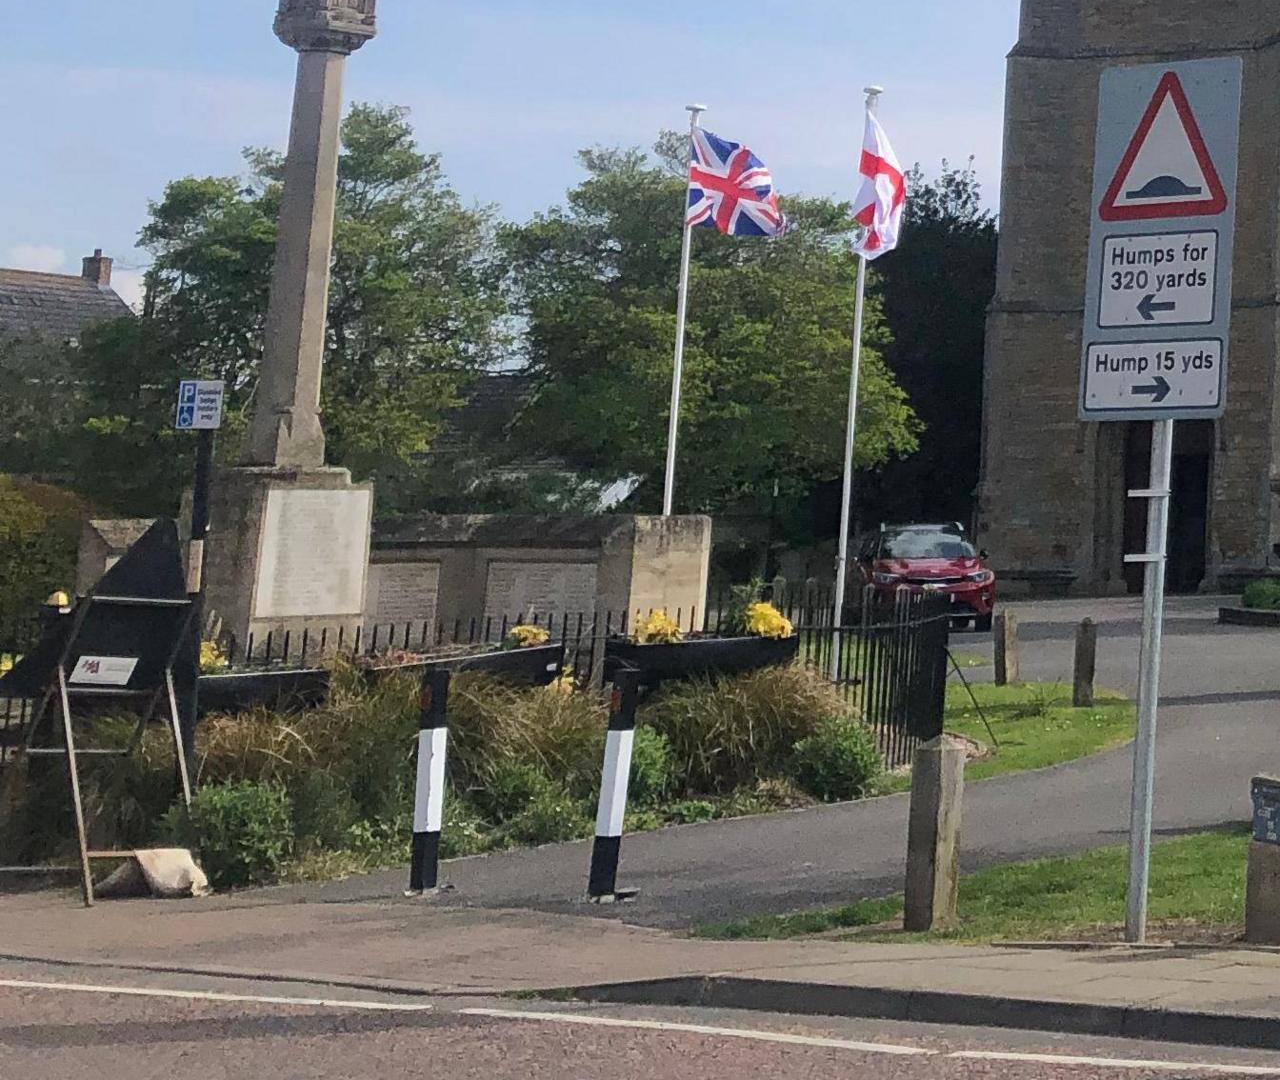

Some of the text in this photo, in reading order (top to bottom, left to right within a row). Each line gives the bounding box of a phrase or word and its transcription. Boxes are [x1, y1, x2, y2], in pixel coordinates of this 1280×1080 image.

[1111, 242, 1209, 267] Humps for
[1110, 267, 1207, 293] 320 yards
[1095, 349, 1213, 375] Hump 15 yds
[184, 385, 194, 402] P
